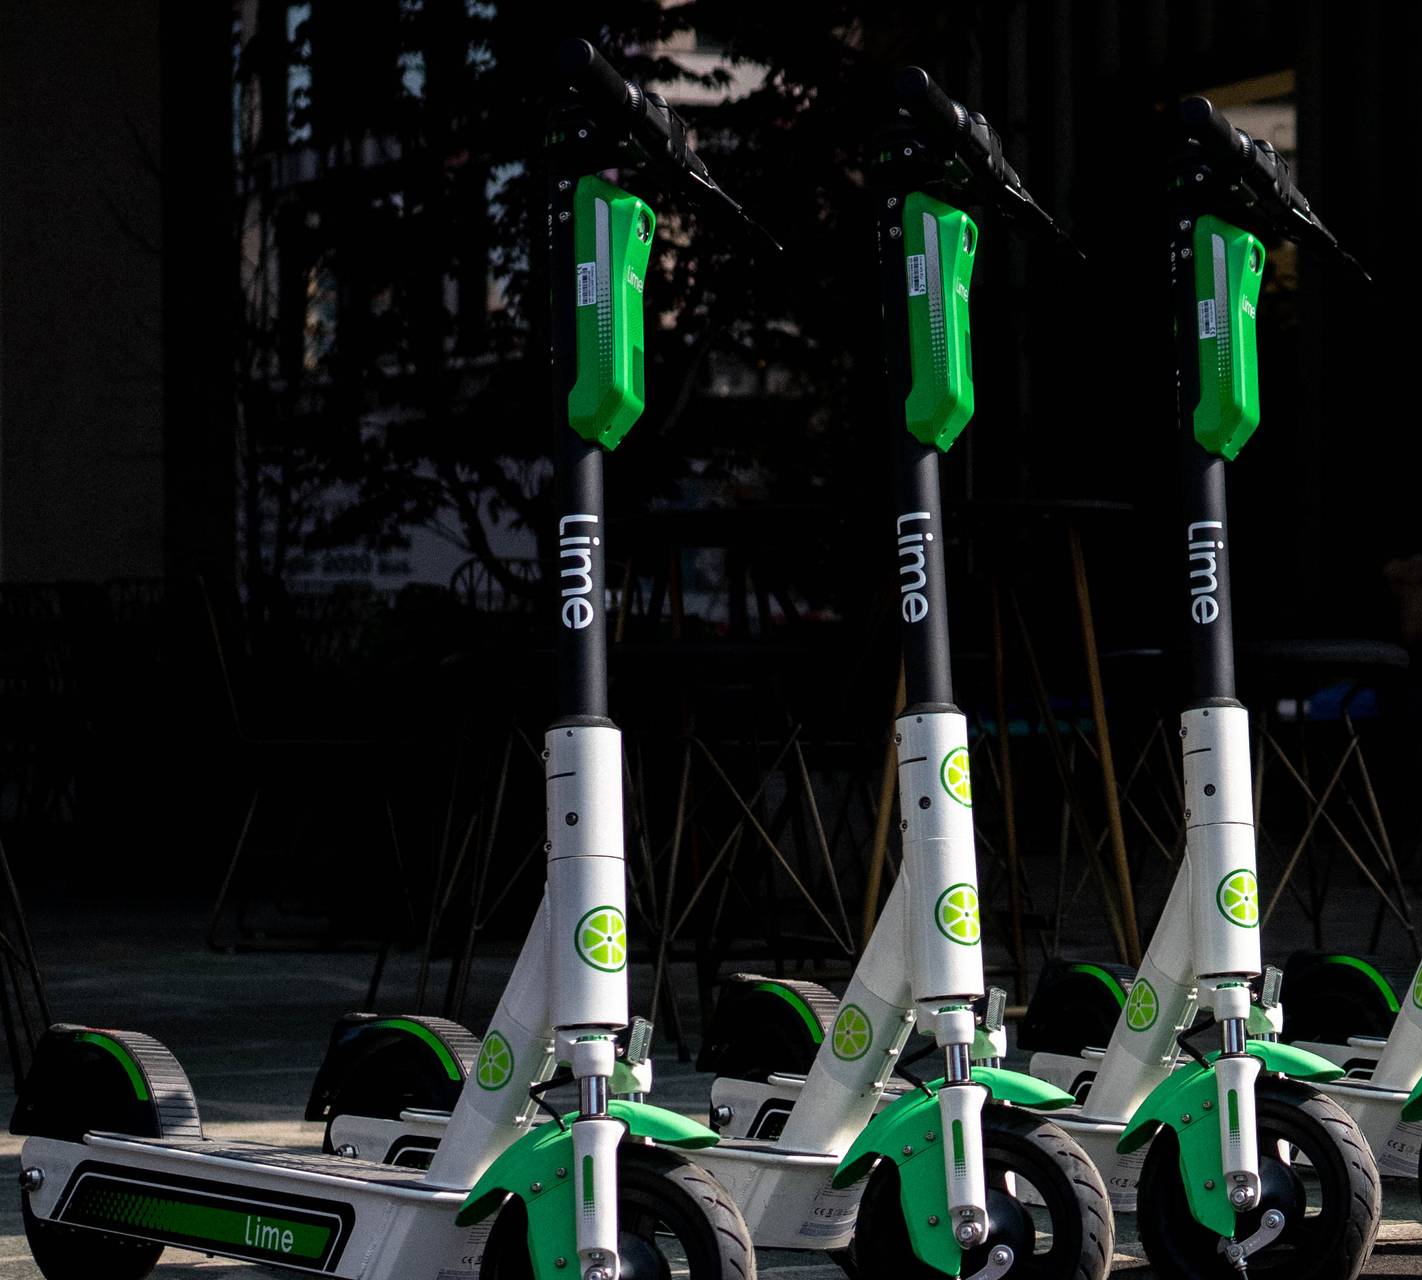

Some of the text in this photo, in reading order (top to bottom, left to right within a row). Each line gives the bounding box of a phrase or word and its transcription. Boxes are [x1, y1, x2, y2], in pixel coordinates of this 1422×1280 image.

[560, 514, 600, 629] Lime
[897, 512, 933, 623] Lime
[1188, 521, 1224, 624] Lime
[245, 1215, 294, 1253] Lime
